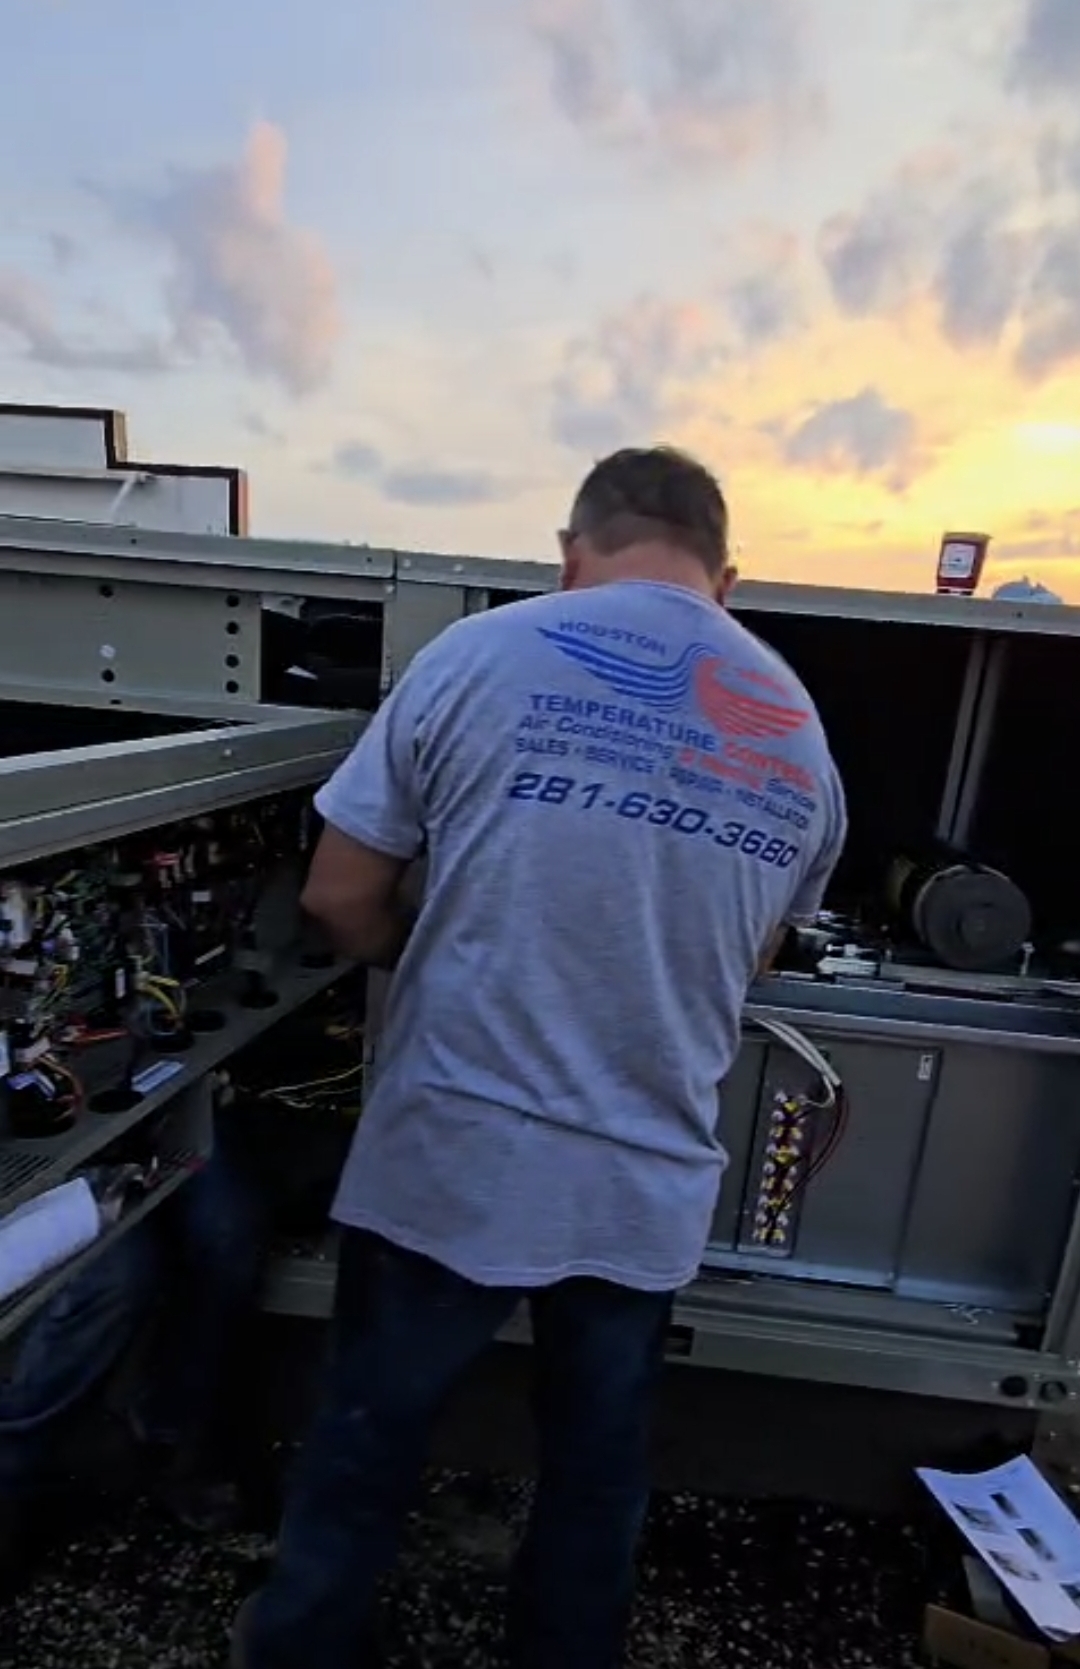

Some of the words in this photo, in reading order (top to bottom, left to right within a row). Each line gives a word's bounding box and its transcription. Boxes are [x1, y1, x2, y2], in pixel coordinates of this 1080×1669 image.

[559, 621, 666, 656] HOUSTON
[519, 714, 551, 731] Air
[529, 694, 717, 751] TEMPERATURE
[515, 737, 569, 756] SALES
[585, 745, 655, 774] SERVICE
[508, 771, 800, 869] 281-630-3680
